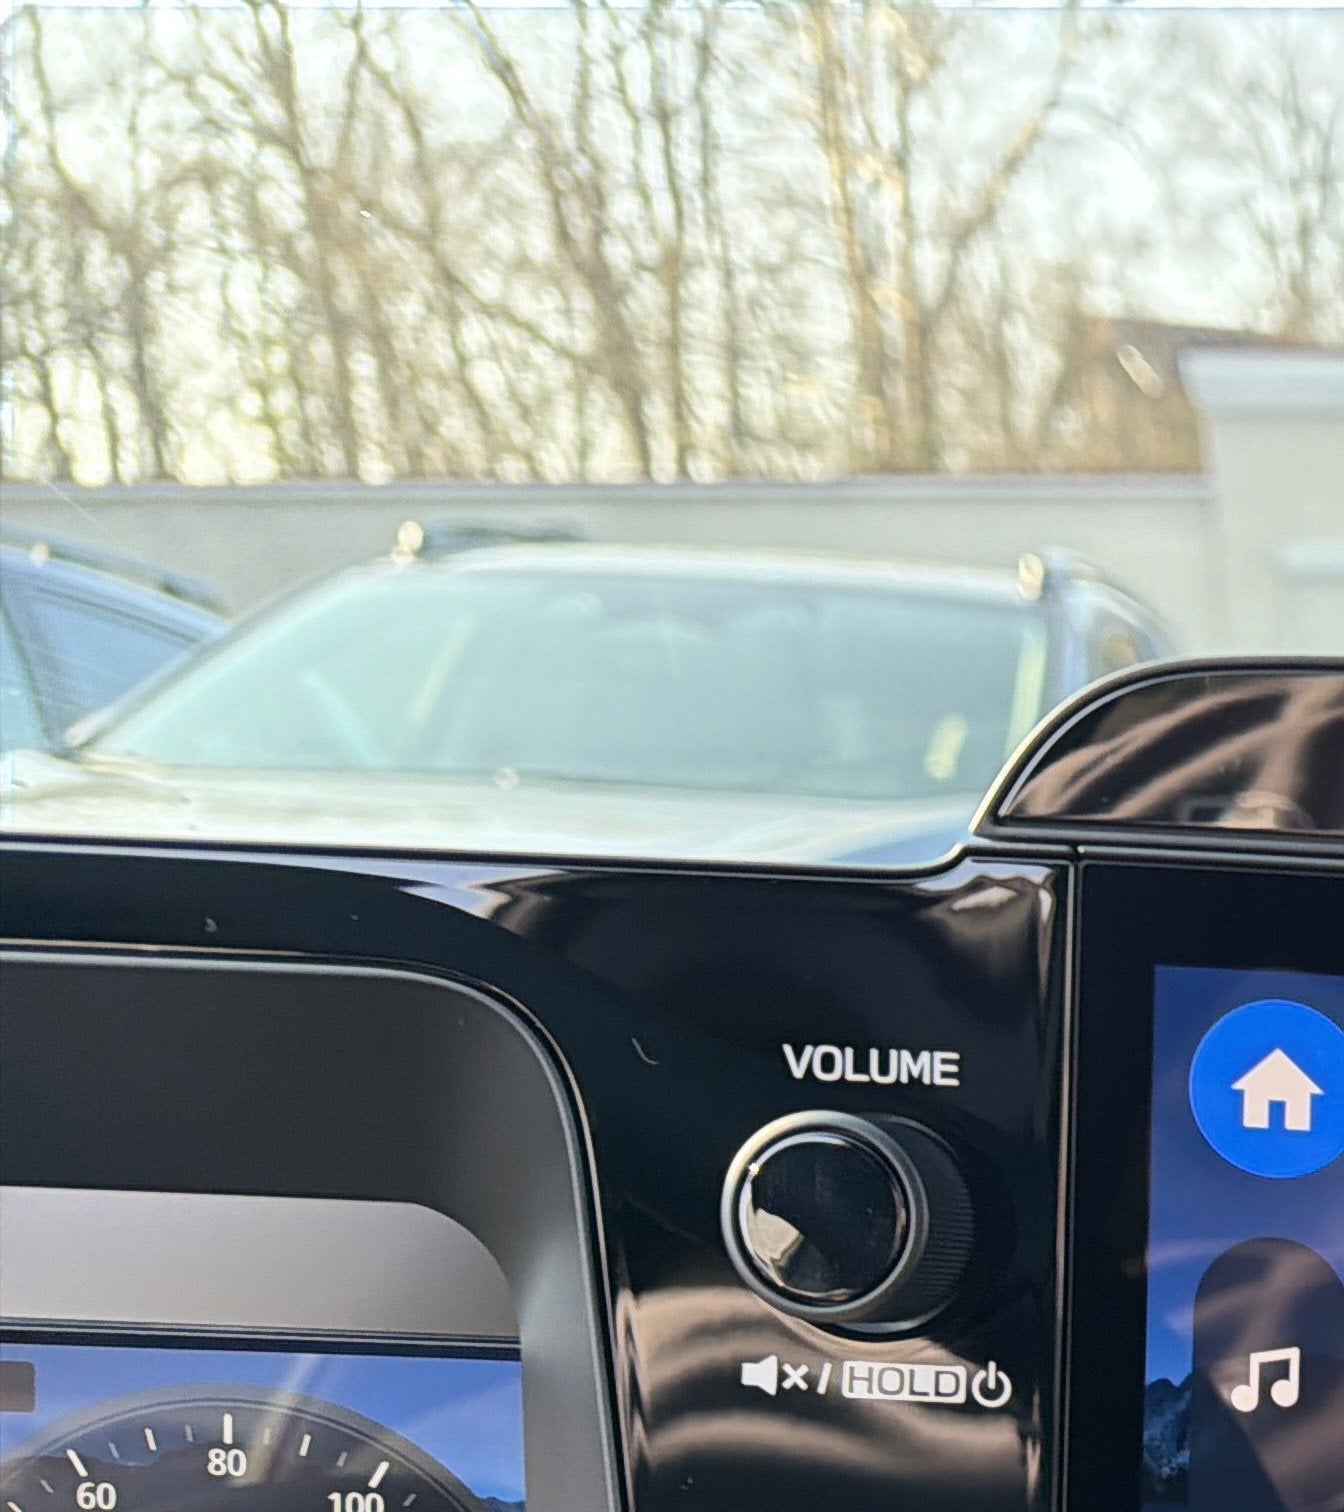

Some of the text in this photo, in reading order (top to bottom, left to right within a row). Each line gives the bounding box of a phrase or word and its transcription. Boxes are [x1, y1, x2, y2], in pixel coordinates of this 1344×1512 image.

[782, 1043, 961, 1087] VOLUME
[848, 1367, 961, 1397] HOLD
[207, 1447, 247, 1477] 80
[76, 1481, 117, 1511] 60
